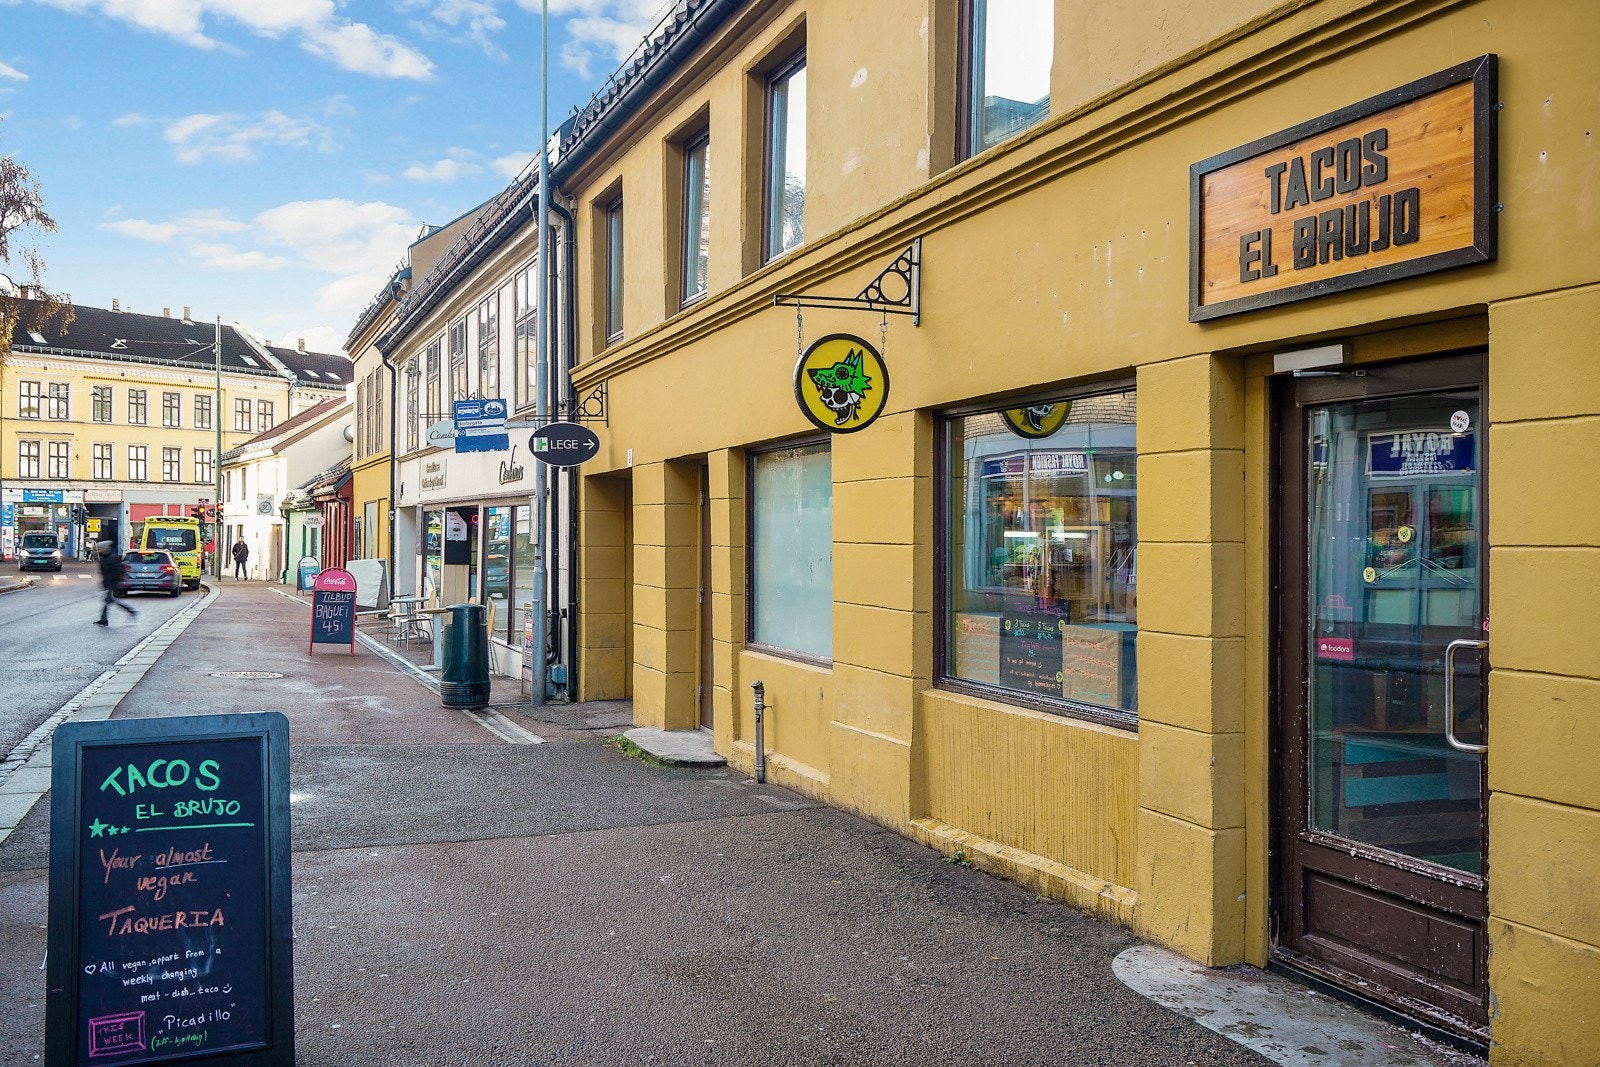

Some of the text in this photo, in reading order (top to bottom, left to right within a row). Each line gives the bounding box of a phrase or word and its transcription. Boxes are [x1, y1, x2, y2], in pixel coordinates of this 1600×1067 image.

[1264, 127, 1388, 215] TACOS
[1239, 187, 1420, 283] EL BRUJO
[550, 439, 579, 450] LEGE
[1328, 644, 1350, 653] foodora
[99, 758, 221, 797] TACOS
[136, 797, 241, 819] EL BRUJO
[99, 843, 214, 884] Your almost
[137, 870, 198, 901] vegan
[99, 961, 115, 973] All
[215, 947, 222, 955] a
[122, 967, 198, 987] weekly changing
[140, 990, 161, 1004] meat
[198, 985, 219, 995] taco
[103, 1032, 134, 1046] WEEK
